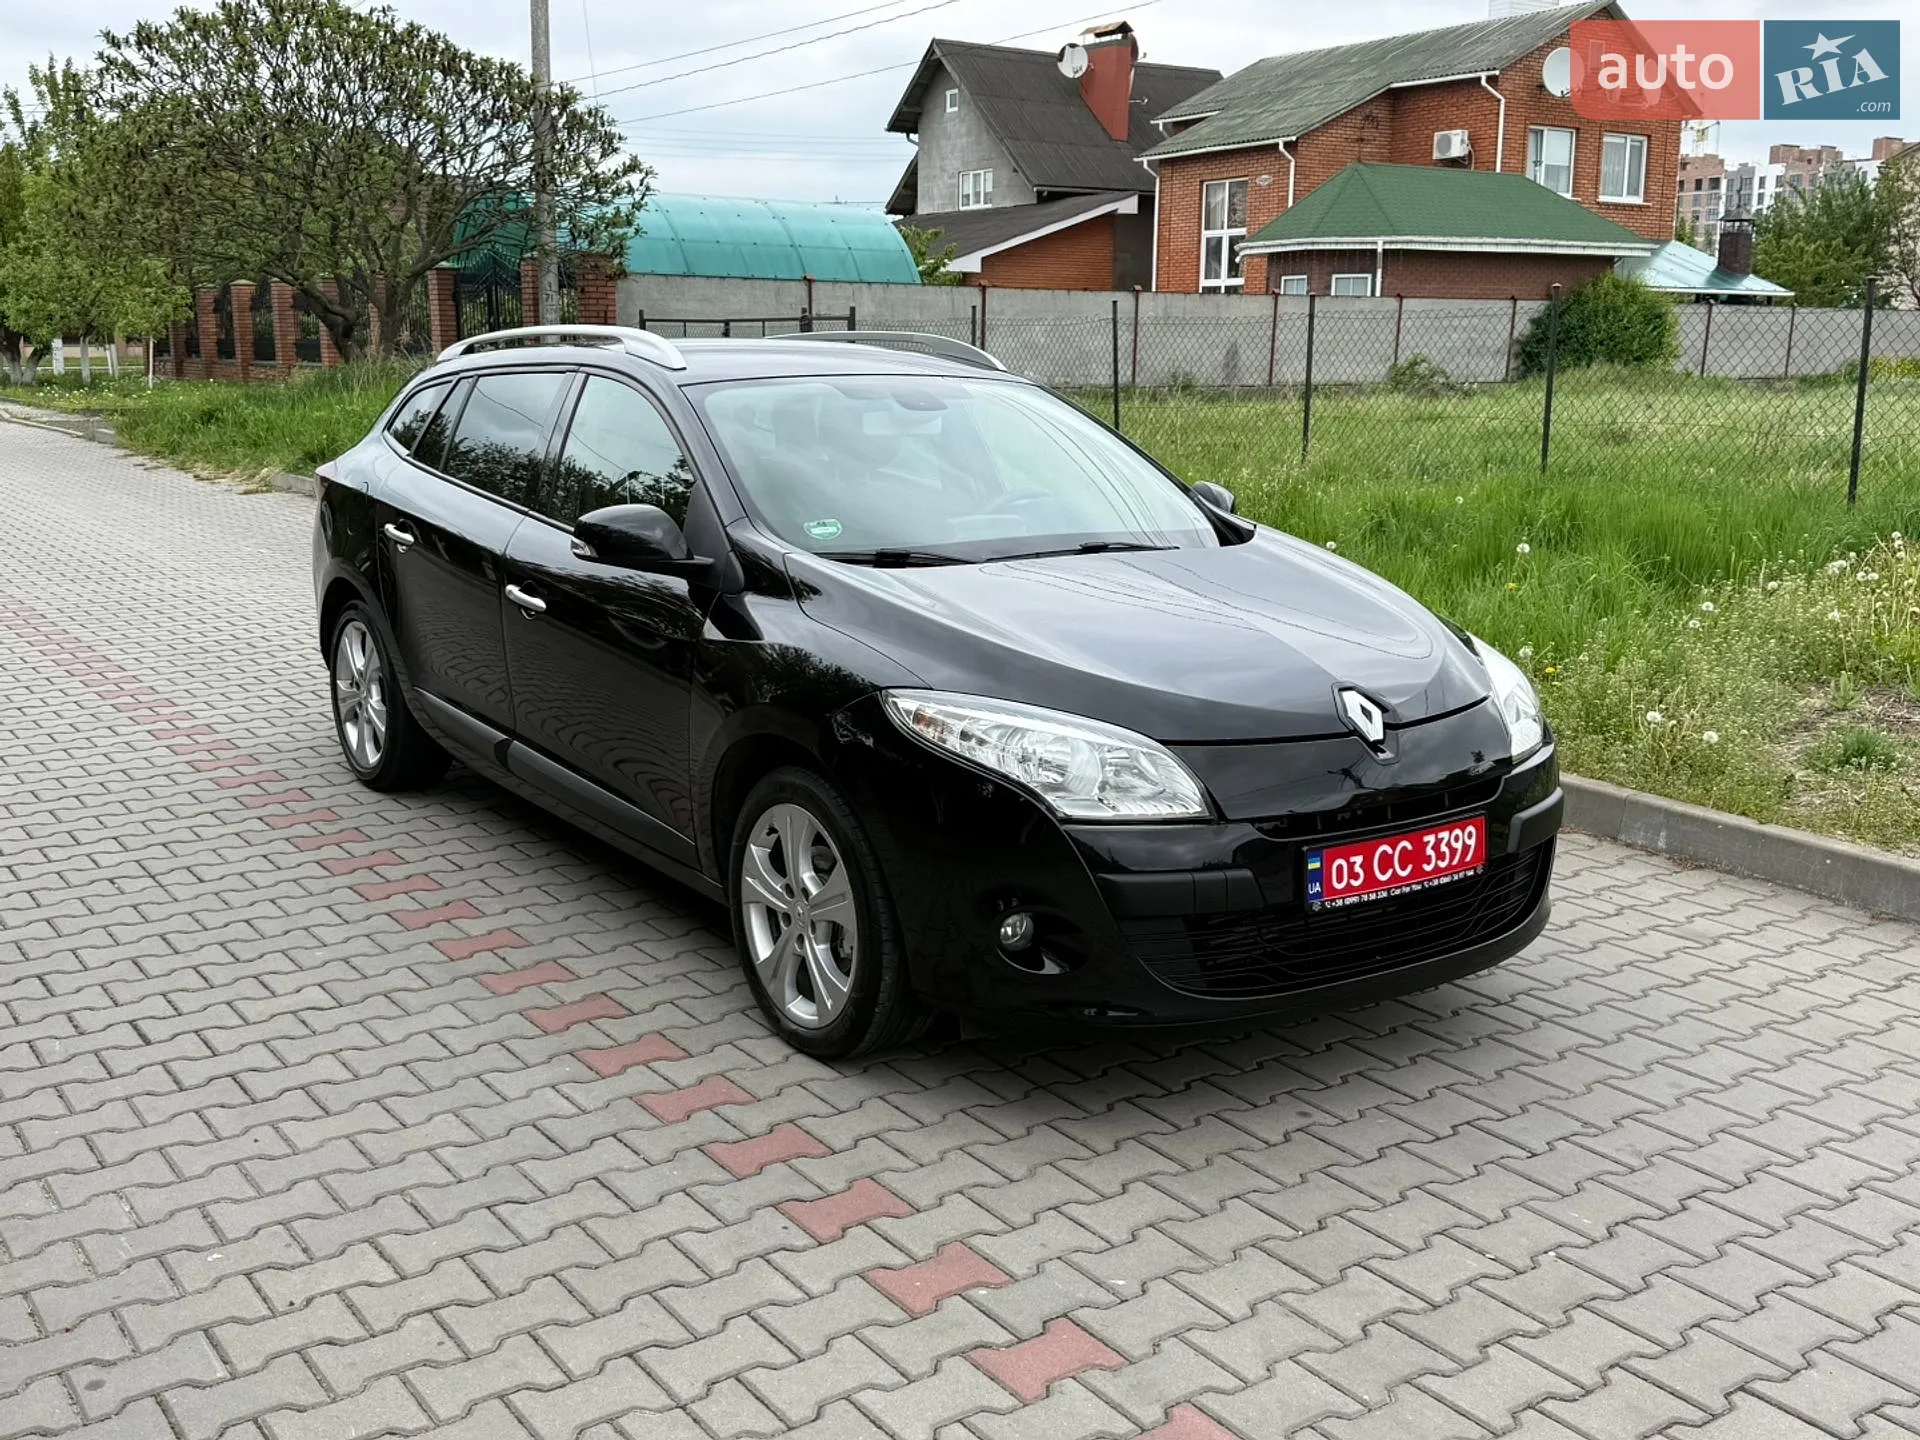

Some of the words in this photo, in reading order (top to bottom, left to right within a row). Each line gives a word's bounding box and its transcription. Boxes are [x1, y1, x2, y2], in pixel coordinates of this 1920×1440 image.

[1331, 855, 1365, 890] 03
[1373, 840, 1413, 882] CC
[1422, 825, 1477, 872] 3399
[1308, 883, 1321, 895] UA
[1390, 888, 1400, 896] Car
